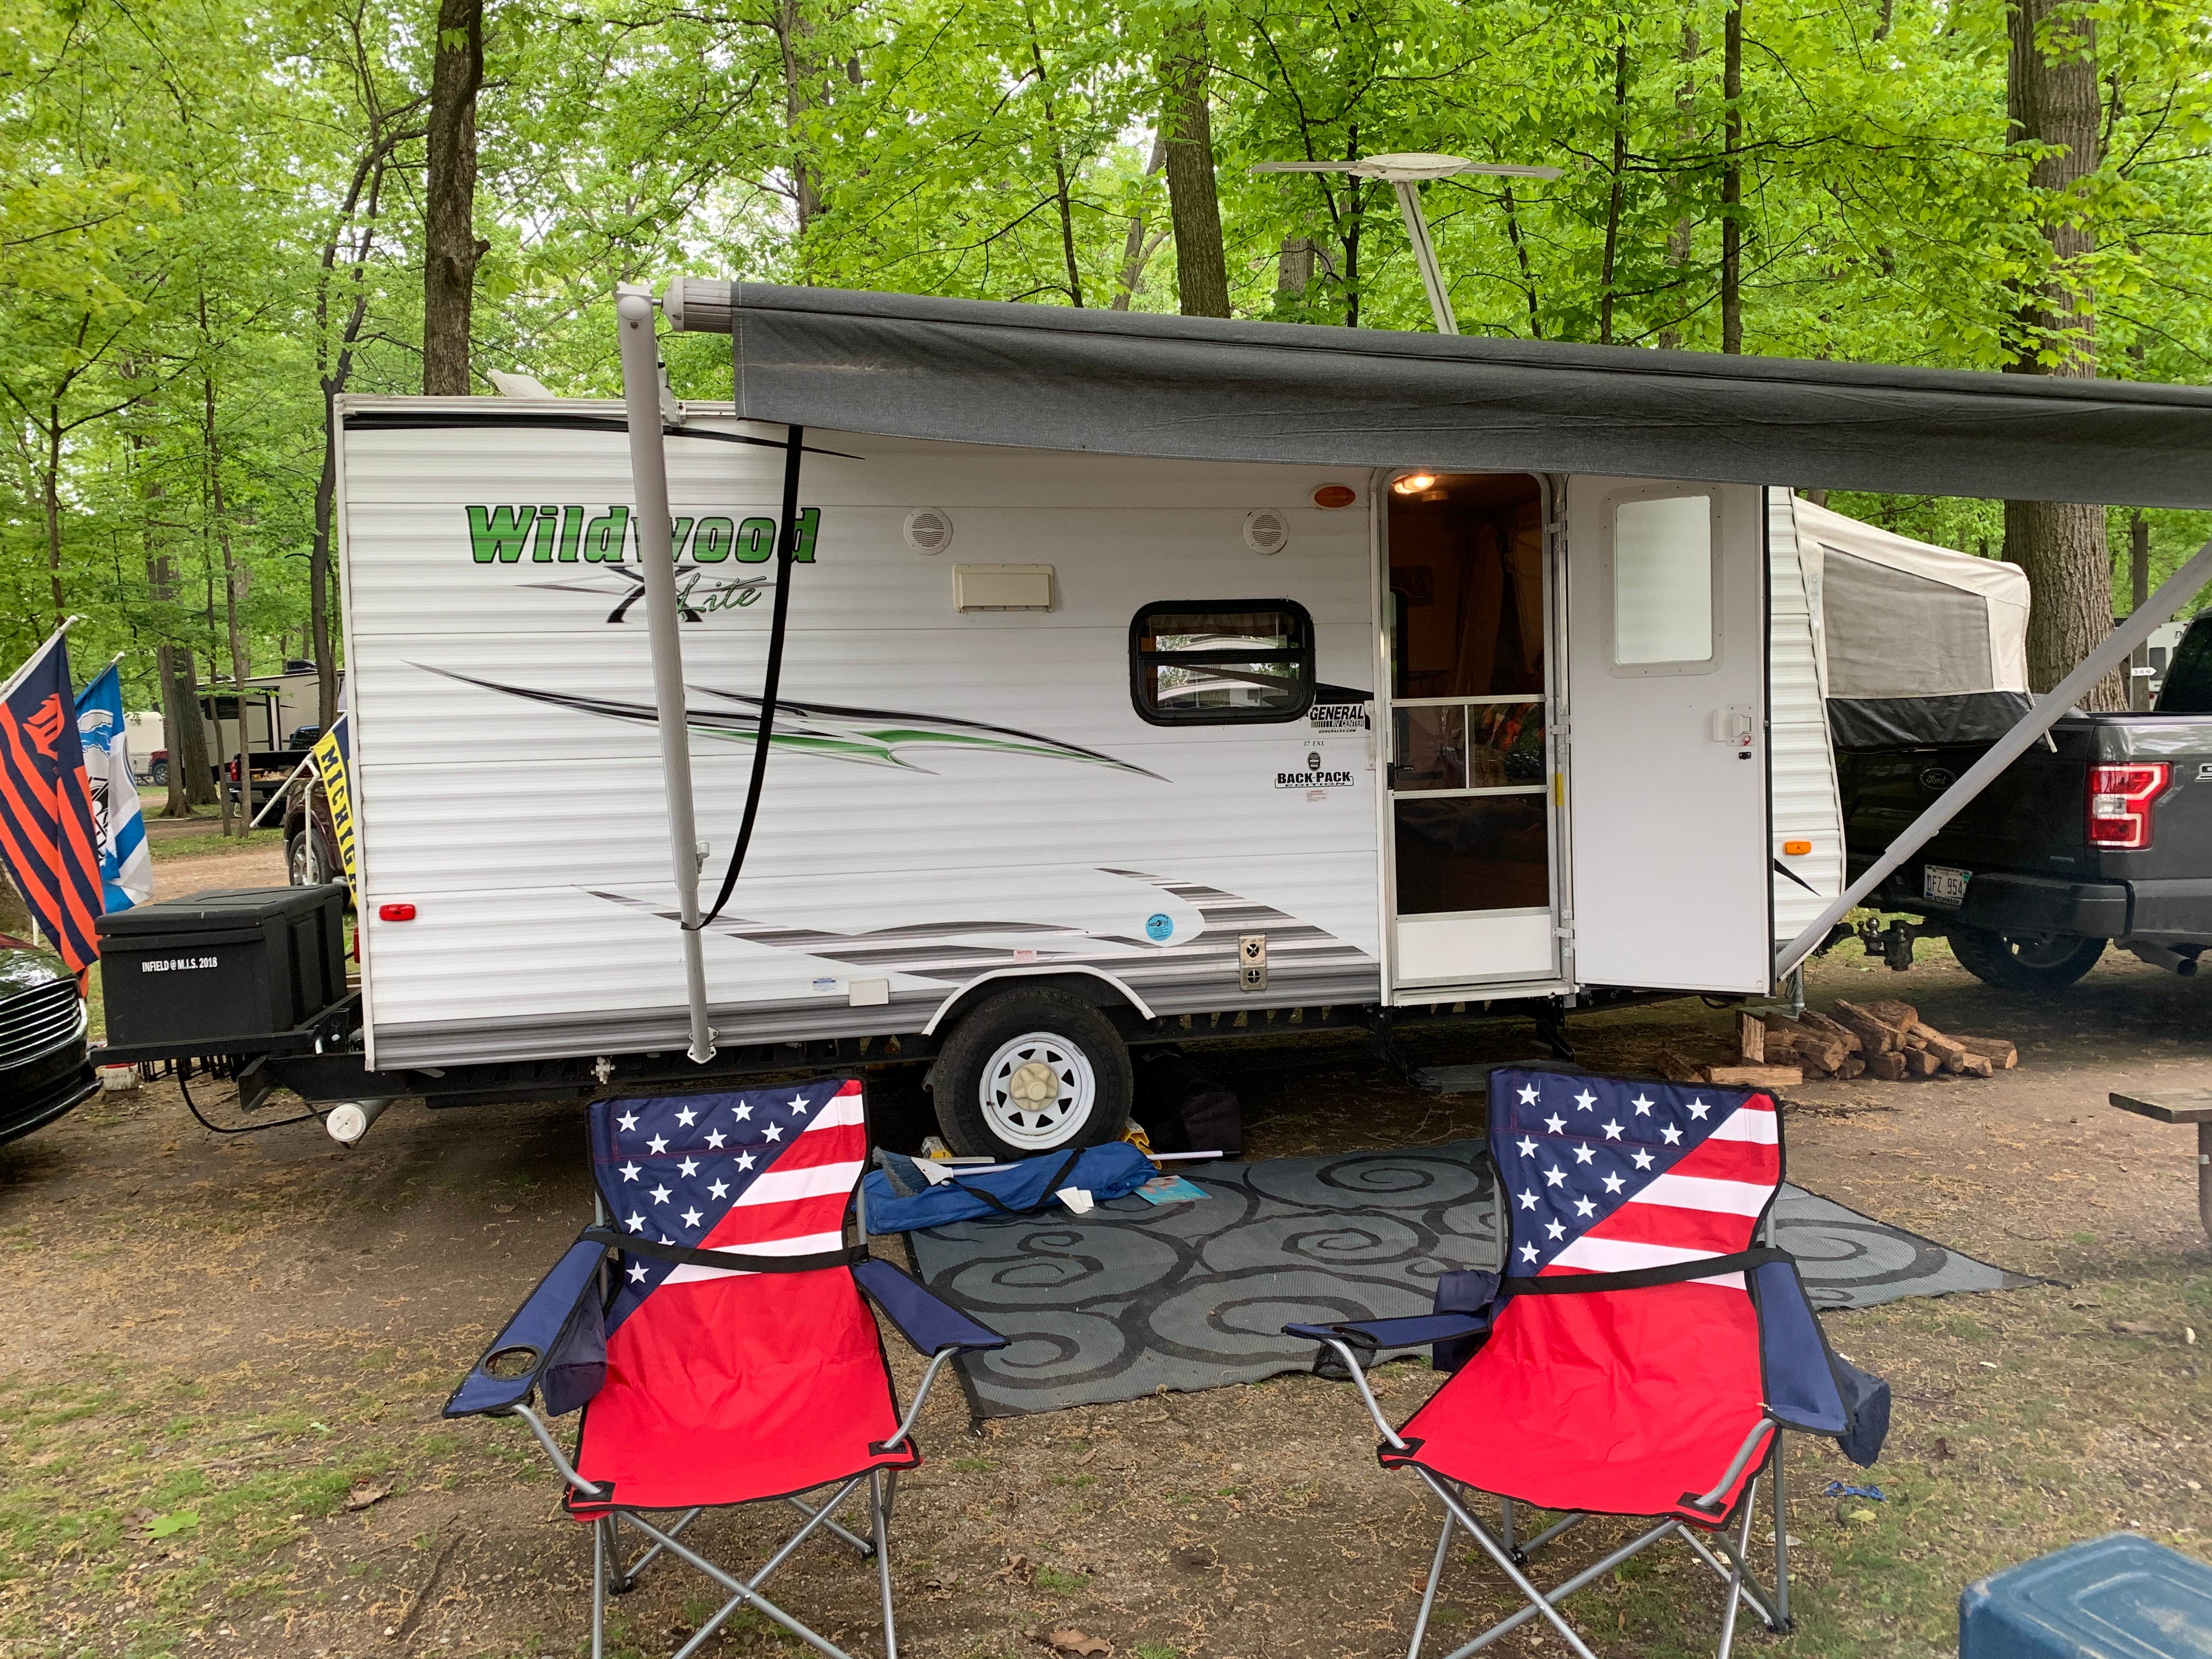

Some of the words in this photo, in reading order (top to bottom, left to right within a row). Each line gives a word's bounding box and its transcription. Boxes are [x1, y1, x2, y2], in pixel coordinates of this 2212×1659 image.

[1310, 706, 1364, 720] GENERAL
[142, 960, 170, 973] INFIELD
[170, 960, 177, 970] @
[177, 958, 198, 970] M.I.S.
[199, 957, 218, 968] 2018
